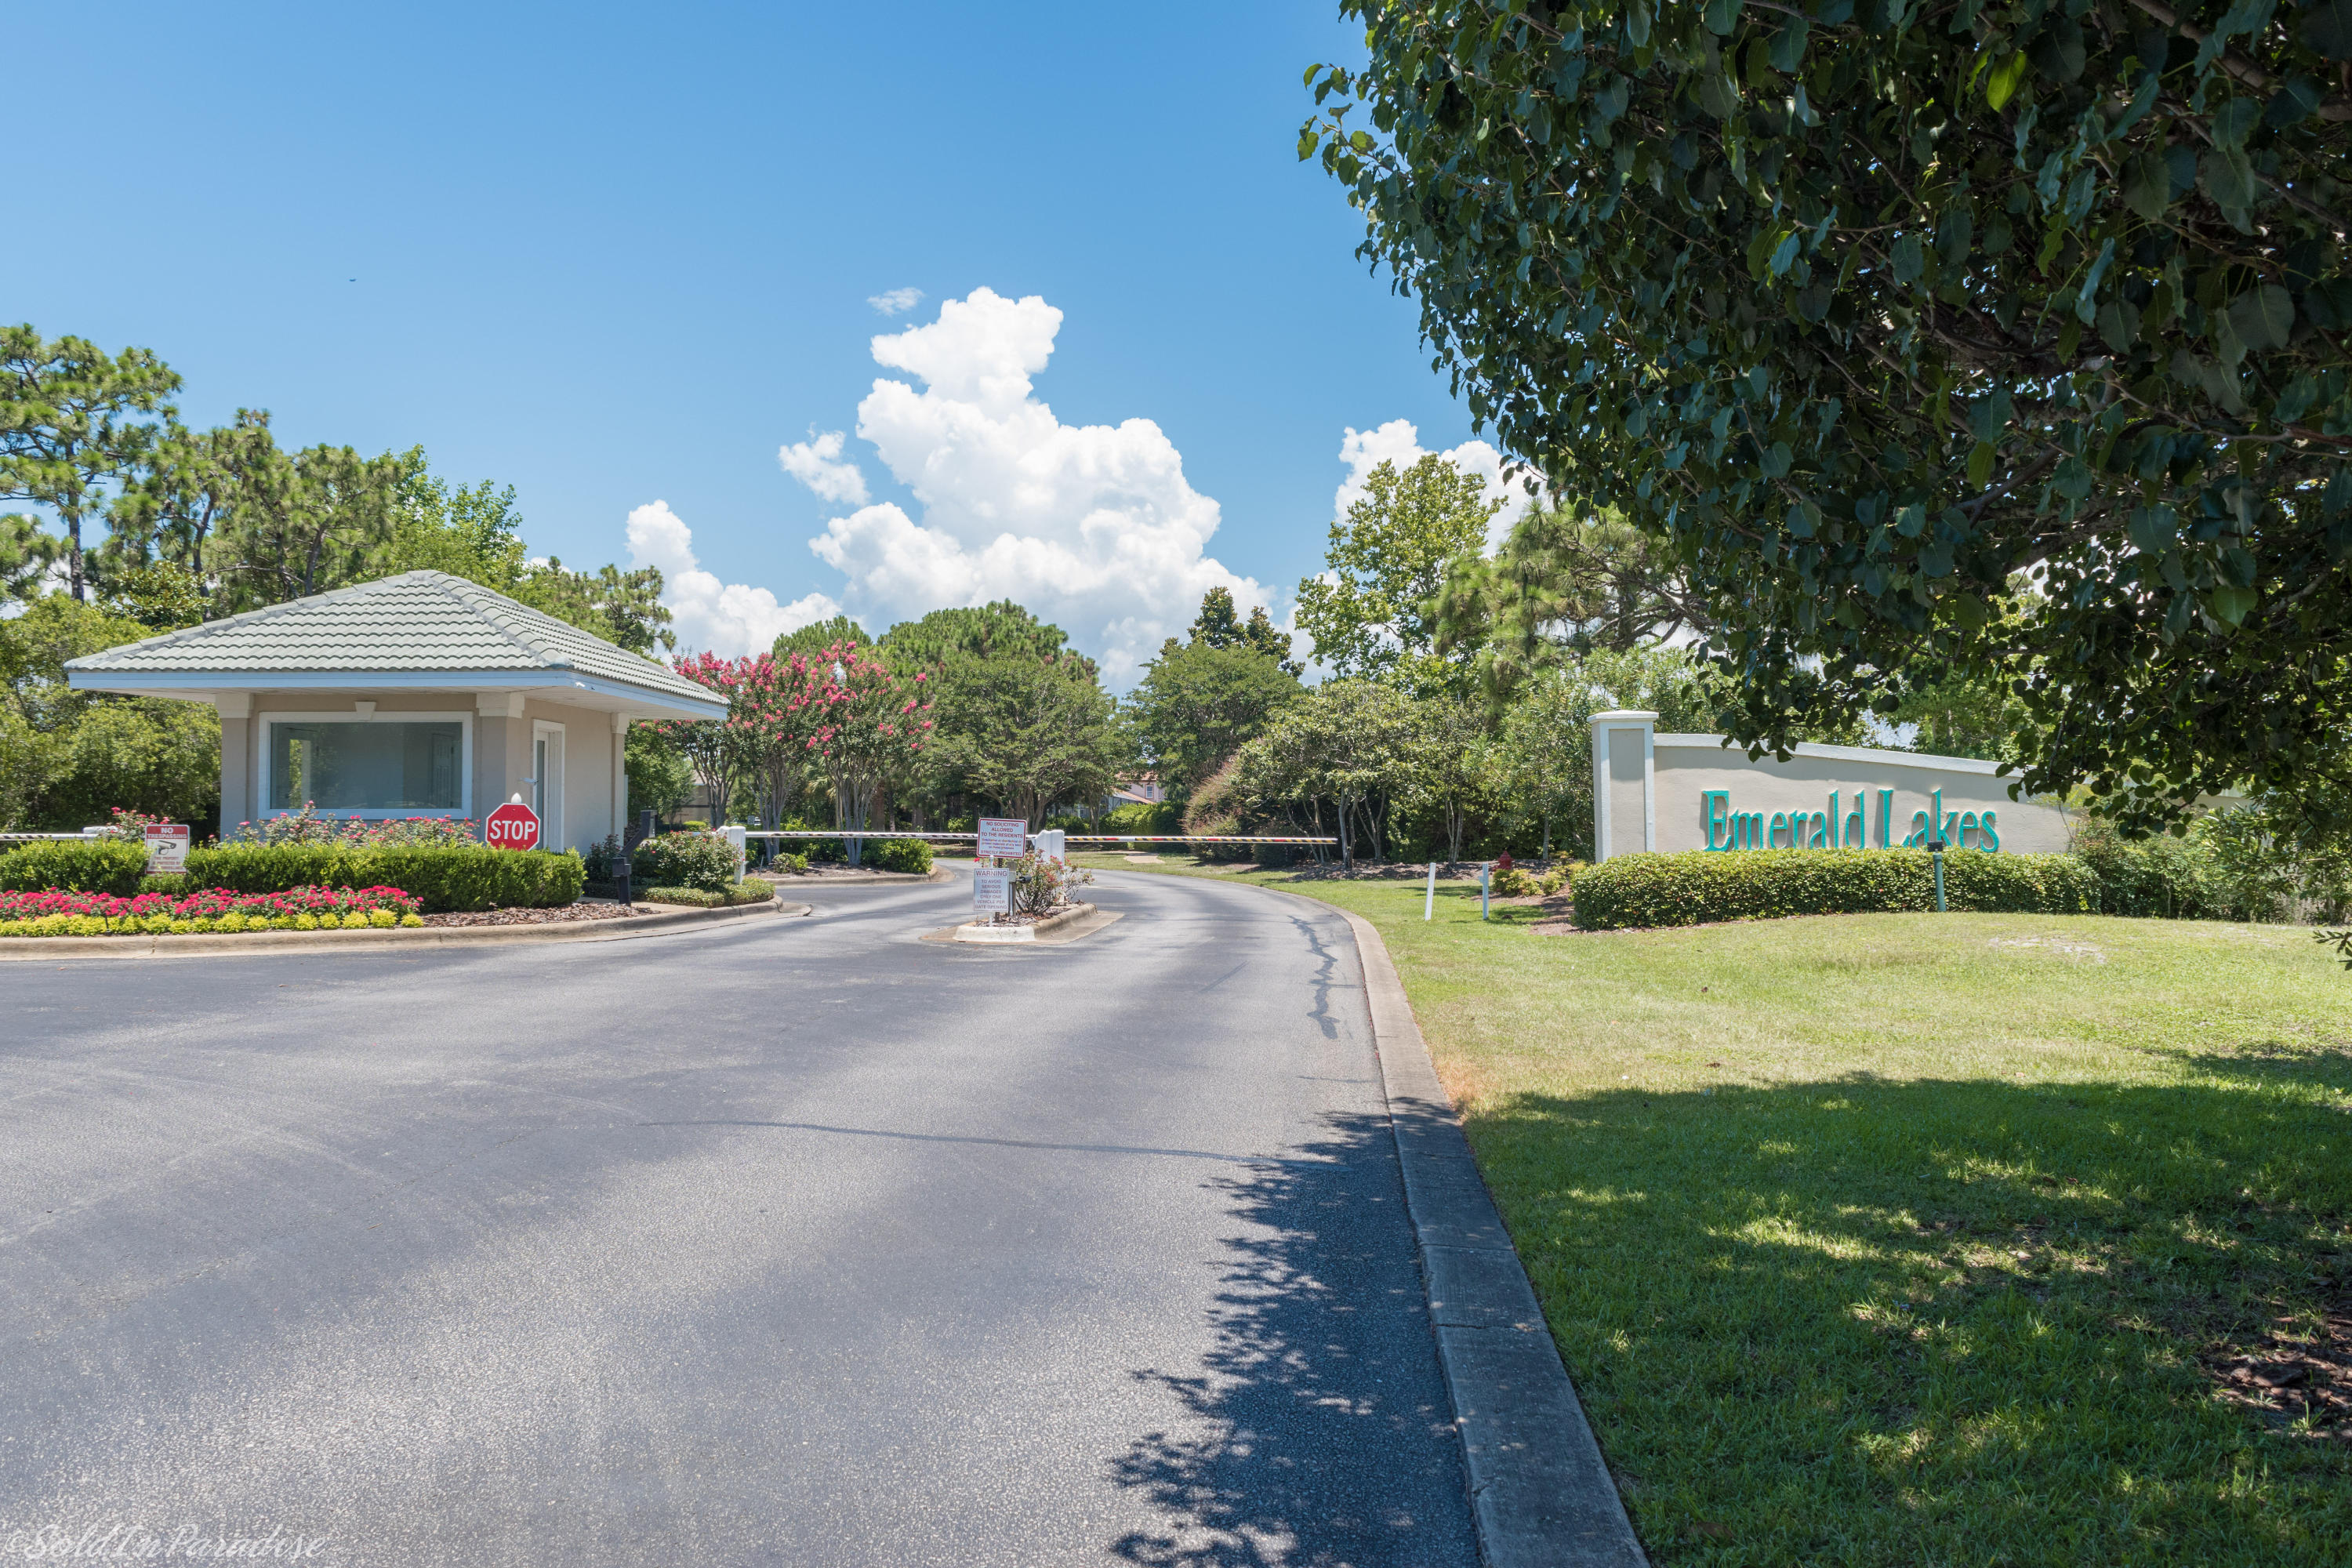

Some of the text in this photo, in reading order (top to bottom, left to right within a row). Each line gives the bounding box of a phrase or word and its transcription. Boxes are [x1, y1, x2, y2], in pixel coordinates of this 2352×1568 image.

[489, 819, 536, 840] STOP
[1702, 788, 2000, 853] Emerald Lakes
